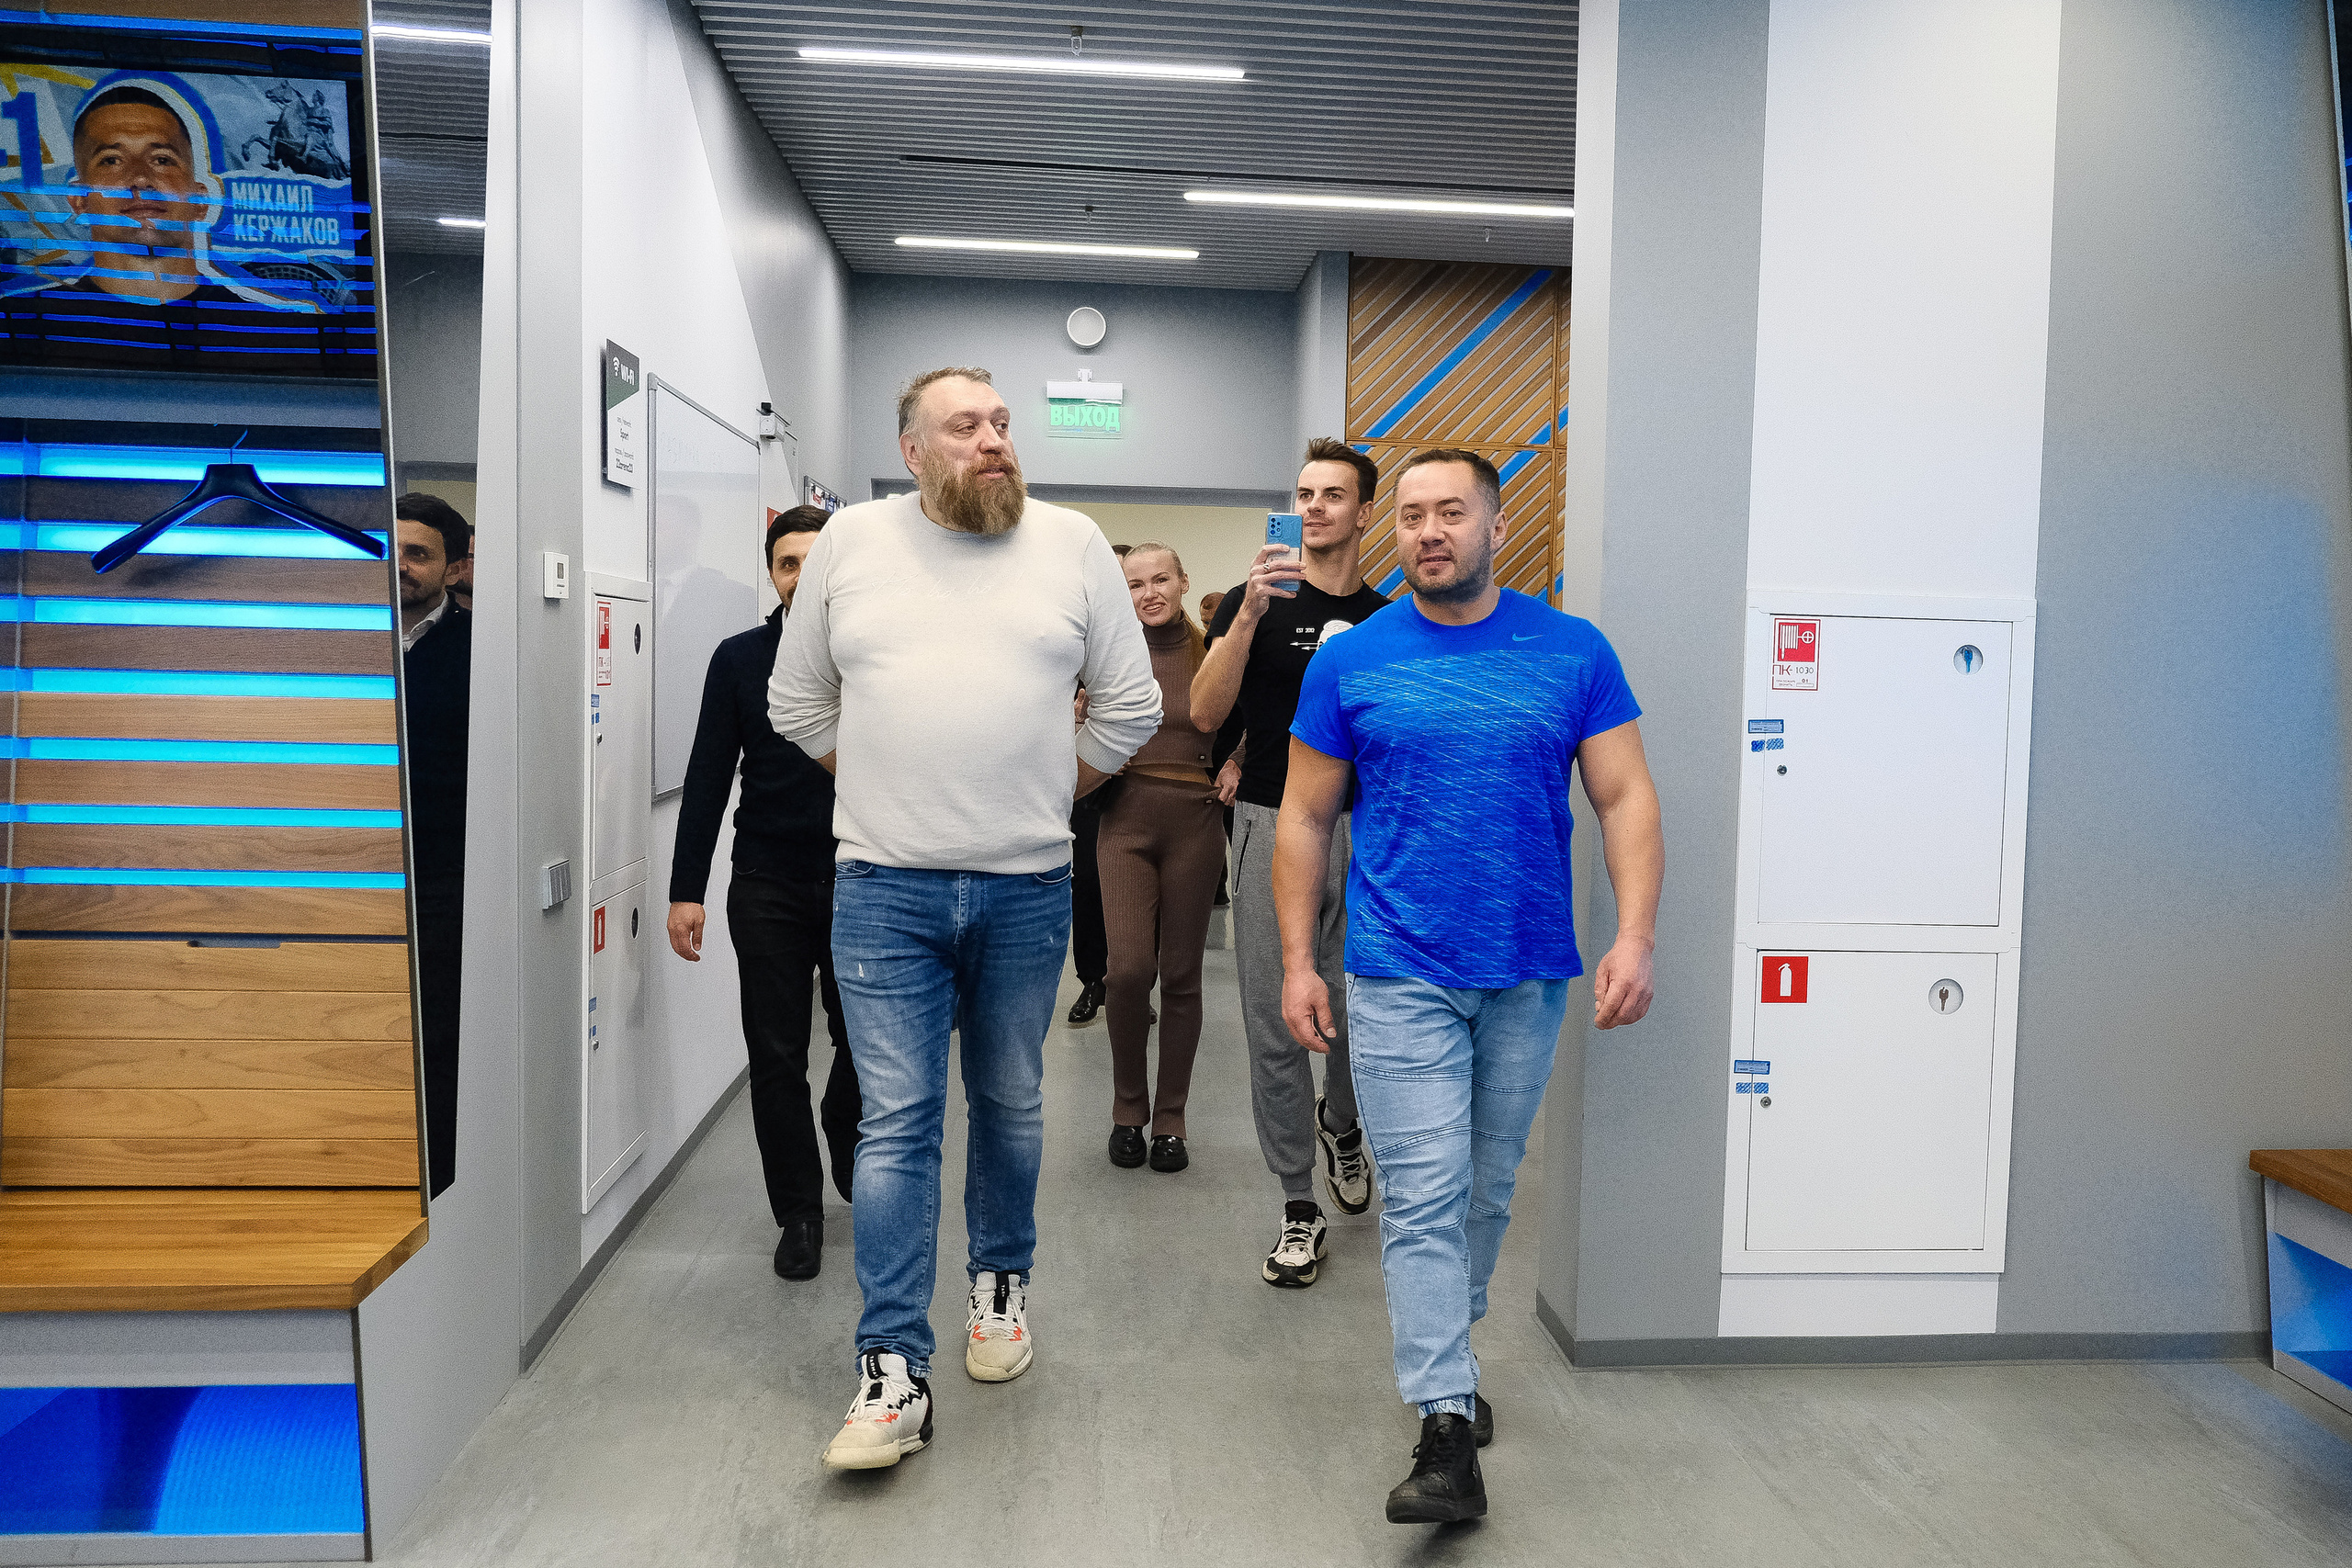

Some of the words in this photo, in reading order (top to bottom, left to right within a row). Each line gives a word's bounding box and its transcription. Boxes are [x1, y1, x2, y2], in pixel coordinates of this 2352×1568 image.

[232, 182, 312, 212] МИХАИЛ
[233, 213, 339, 245] КЕРЖАКОВ
[1050, 405, 1120, 431] ВЫХОД
[1796, 666, 1815, 674] 1030
